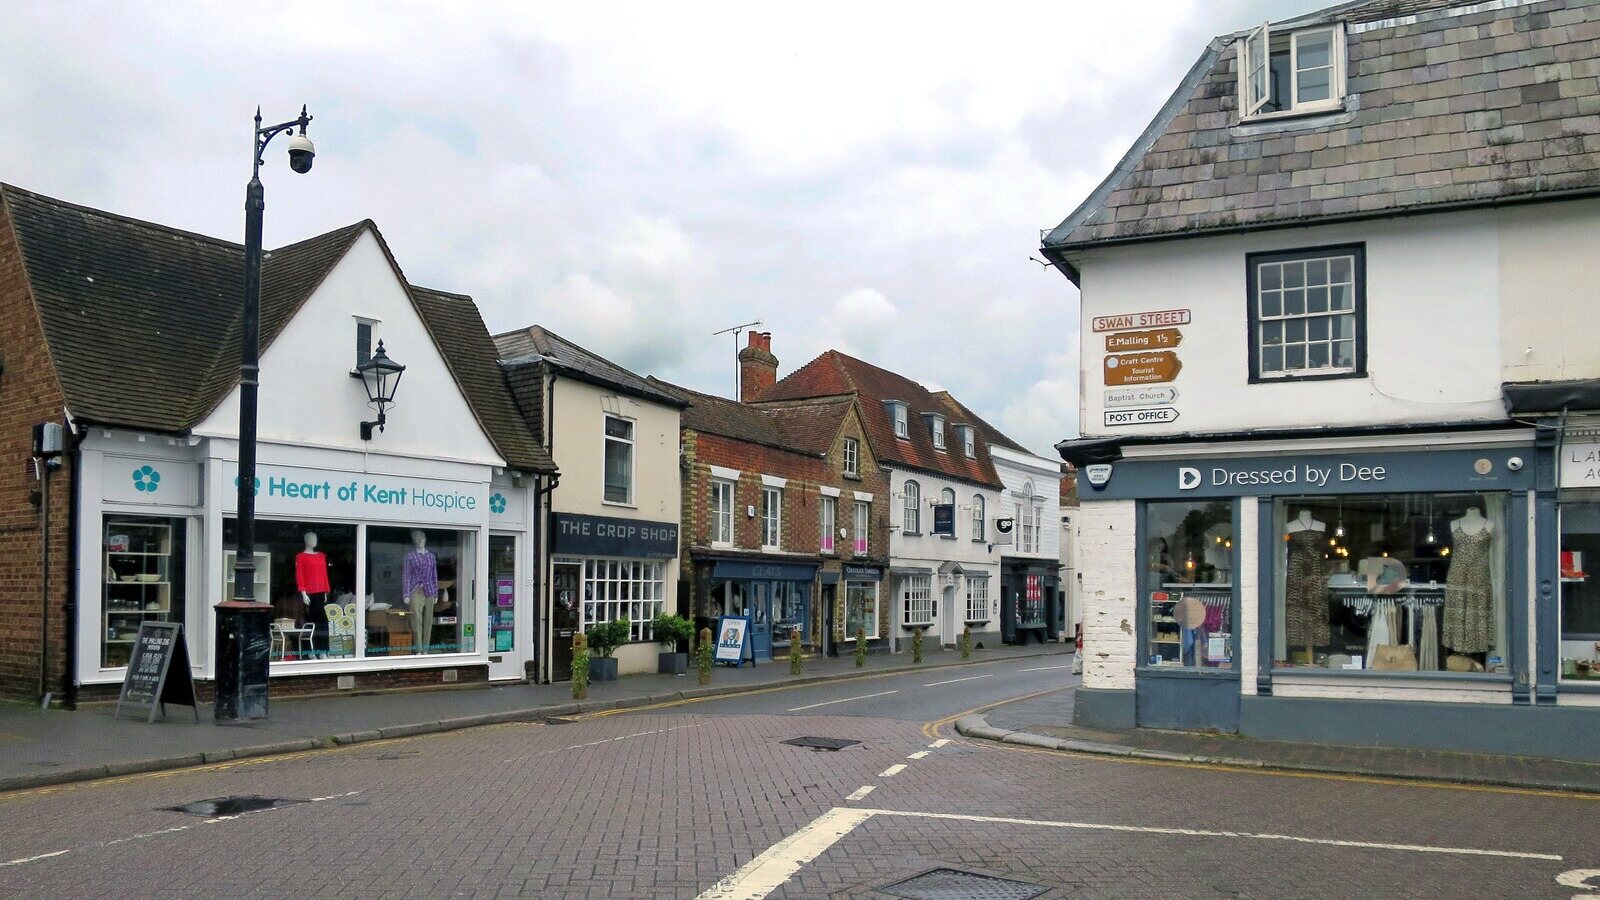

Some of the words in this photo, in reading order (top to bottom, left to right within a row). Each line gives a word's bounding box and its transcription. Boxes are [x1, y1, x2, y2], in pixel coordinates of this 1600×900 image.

[1098, 316, 1133, 330] SWAN
[1140, 311, 1185, 326] STREET
[1108, 336, 1149, 347] E.Malling
[1120, 358, 1138, 366] Craft
[1140, 356, 1164, 364] Centre
[1131, 367, 1155, 375] Tourist
[1124, 374, 1163, 382] Information
[1108, 394, 1135, 402] Baptist
[1139, 392, 1165, 400] Church
[1109, 413, 1134, 422] POST
[1137, 411, 1169, 421] OFFICE
[1212, 465, 1297, 486] Dressed
[1305, 465, 1331, 487] by
[1340, 463, 1386, 481] Dee
[268, 476, 331, 500] Heart
[337, 481, 358, 501] of
[364, 483, 407, 505] Kent
[412, 487, 476, 512] Hospice
[560, 520, 591, 536] THE
[597, 523, 636, 538] CROP
[640, 527, 677, 541] SHOP
